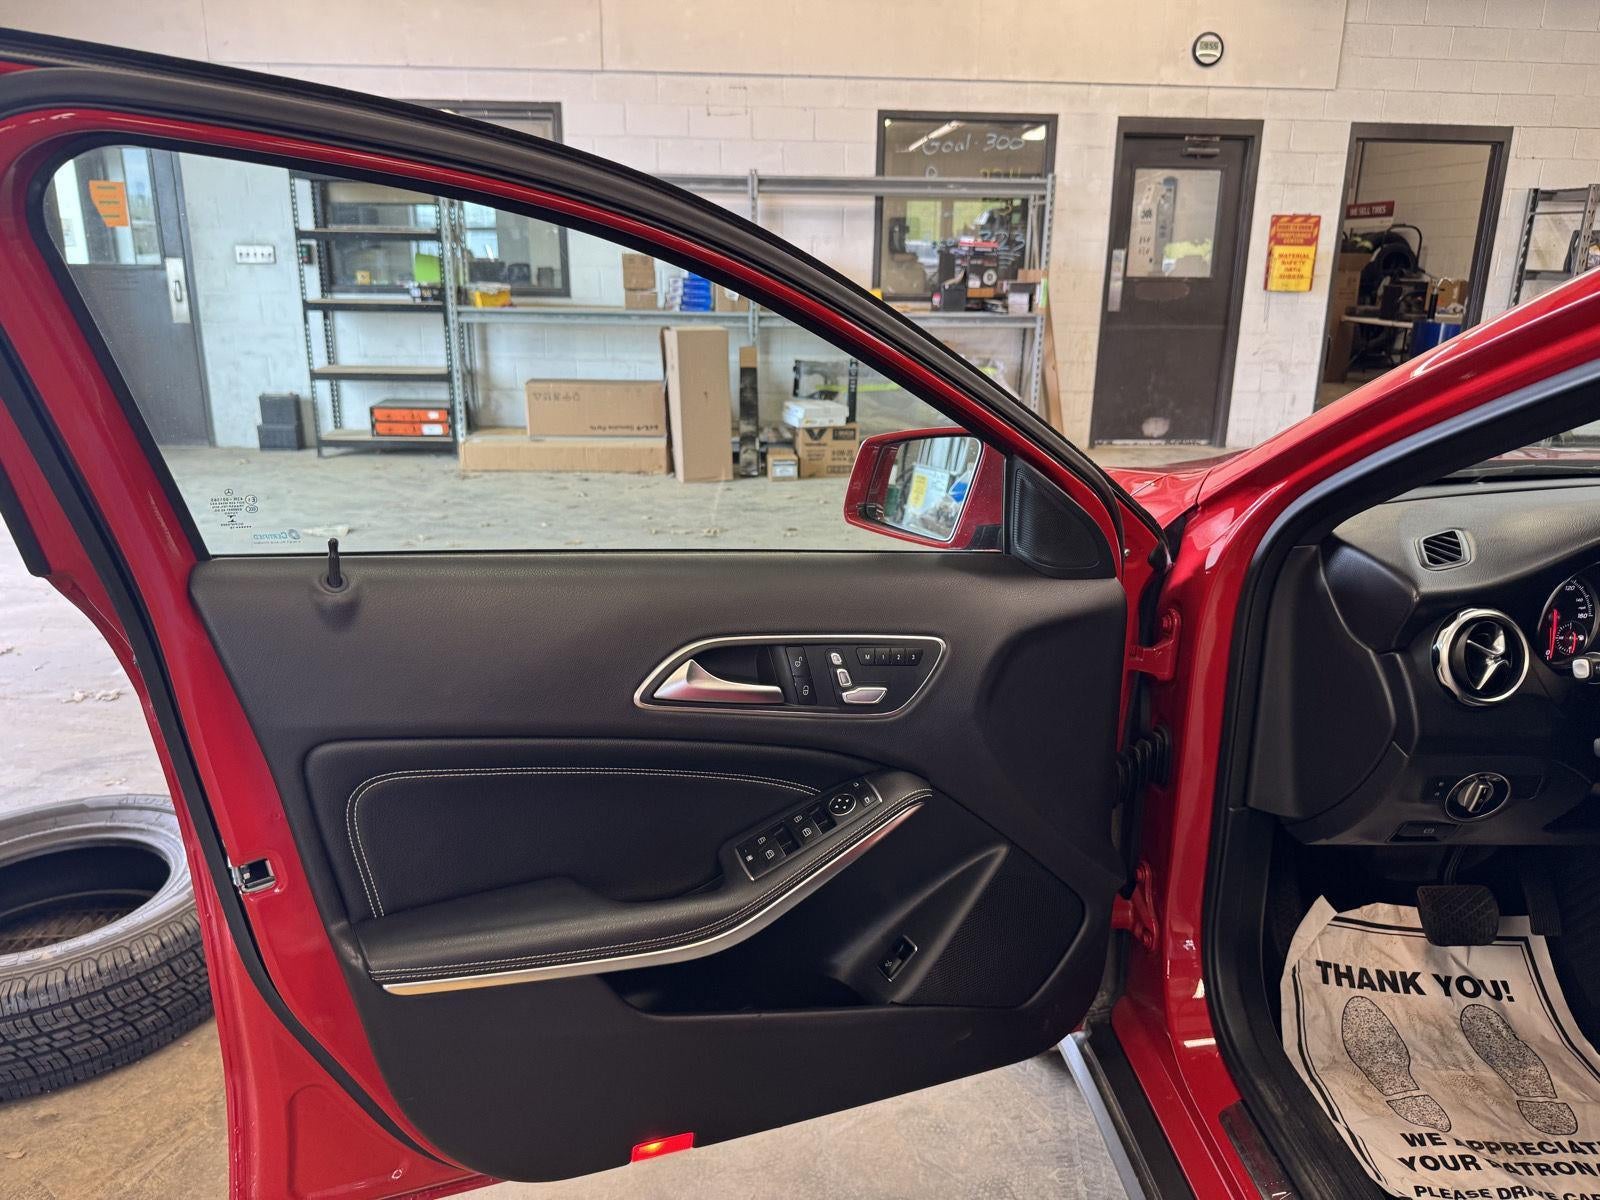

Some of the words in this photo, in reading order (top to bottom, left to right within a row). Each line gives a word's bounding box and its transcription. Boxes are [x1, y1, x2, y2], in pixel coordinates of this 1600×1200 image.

[1315, 959, 1427, 995] THANK
[1432, 973, 1515, 1002] YOU!
[1400, 1132, 1447, 1148] WE
[1453, 1138, 1600, 1155] PPRECIAT
[1398, 1154, 1482, 1172] YOUR
[1414, 1185, 1493, 1200] PLEASE
